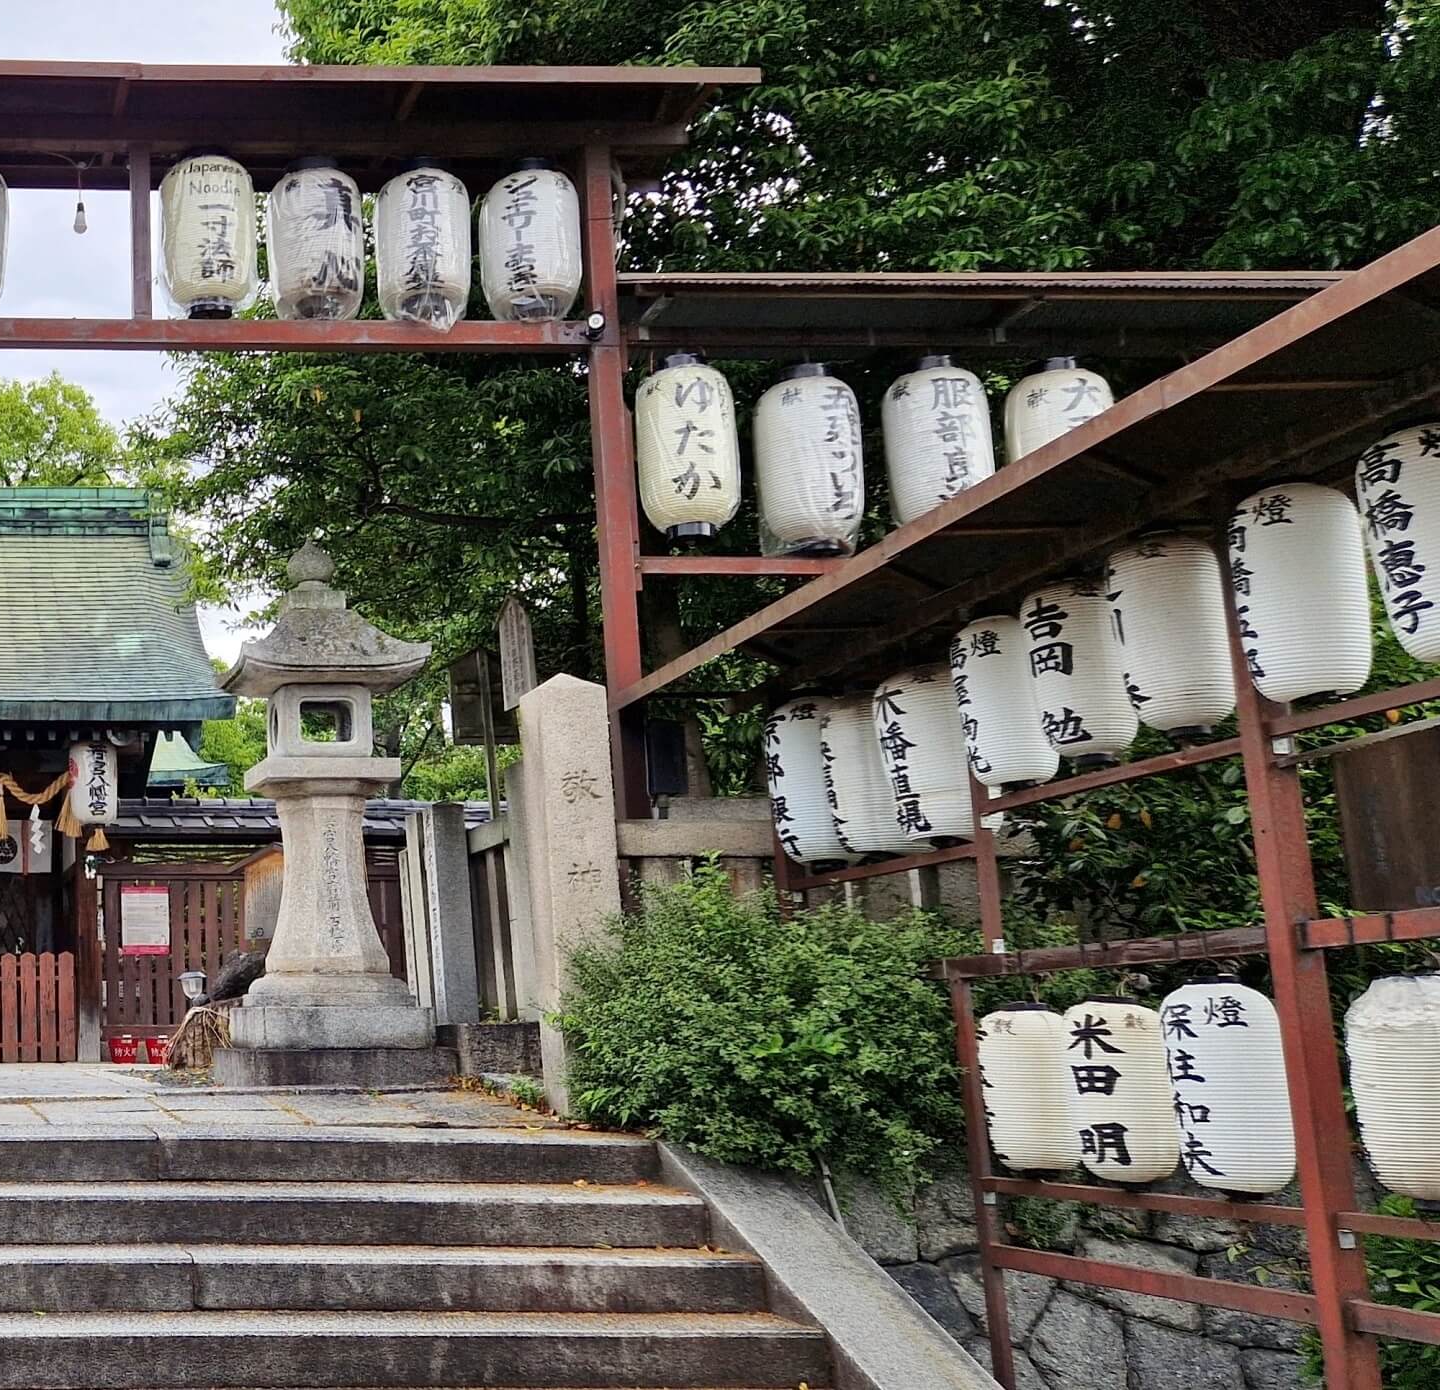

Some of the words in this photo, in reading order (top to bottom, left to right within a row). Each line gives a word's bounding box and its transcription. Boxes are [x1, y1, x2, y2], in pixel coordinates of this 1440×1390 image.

[196, 203, 237, 283] 一寸法師
[671, 376, 723, 501] ゆたか
[1252, 494, 1294, 527] 燈
[970, 629, 1003, 658] 燈
[1023, 597, 1093, 748] 吉岡勉
[1203, 995, 1249, 1028] 燈
[1066, 1012, 1134, 1167] 米田明
